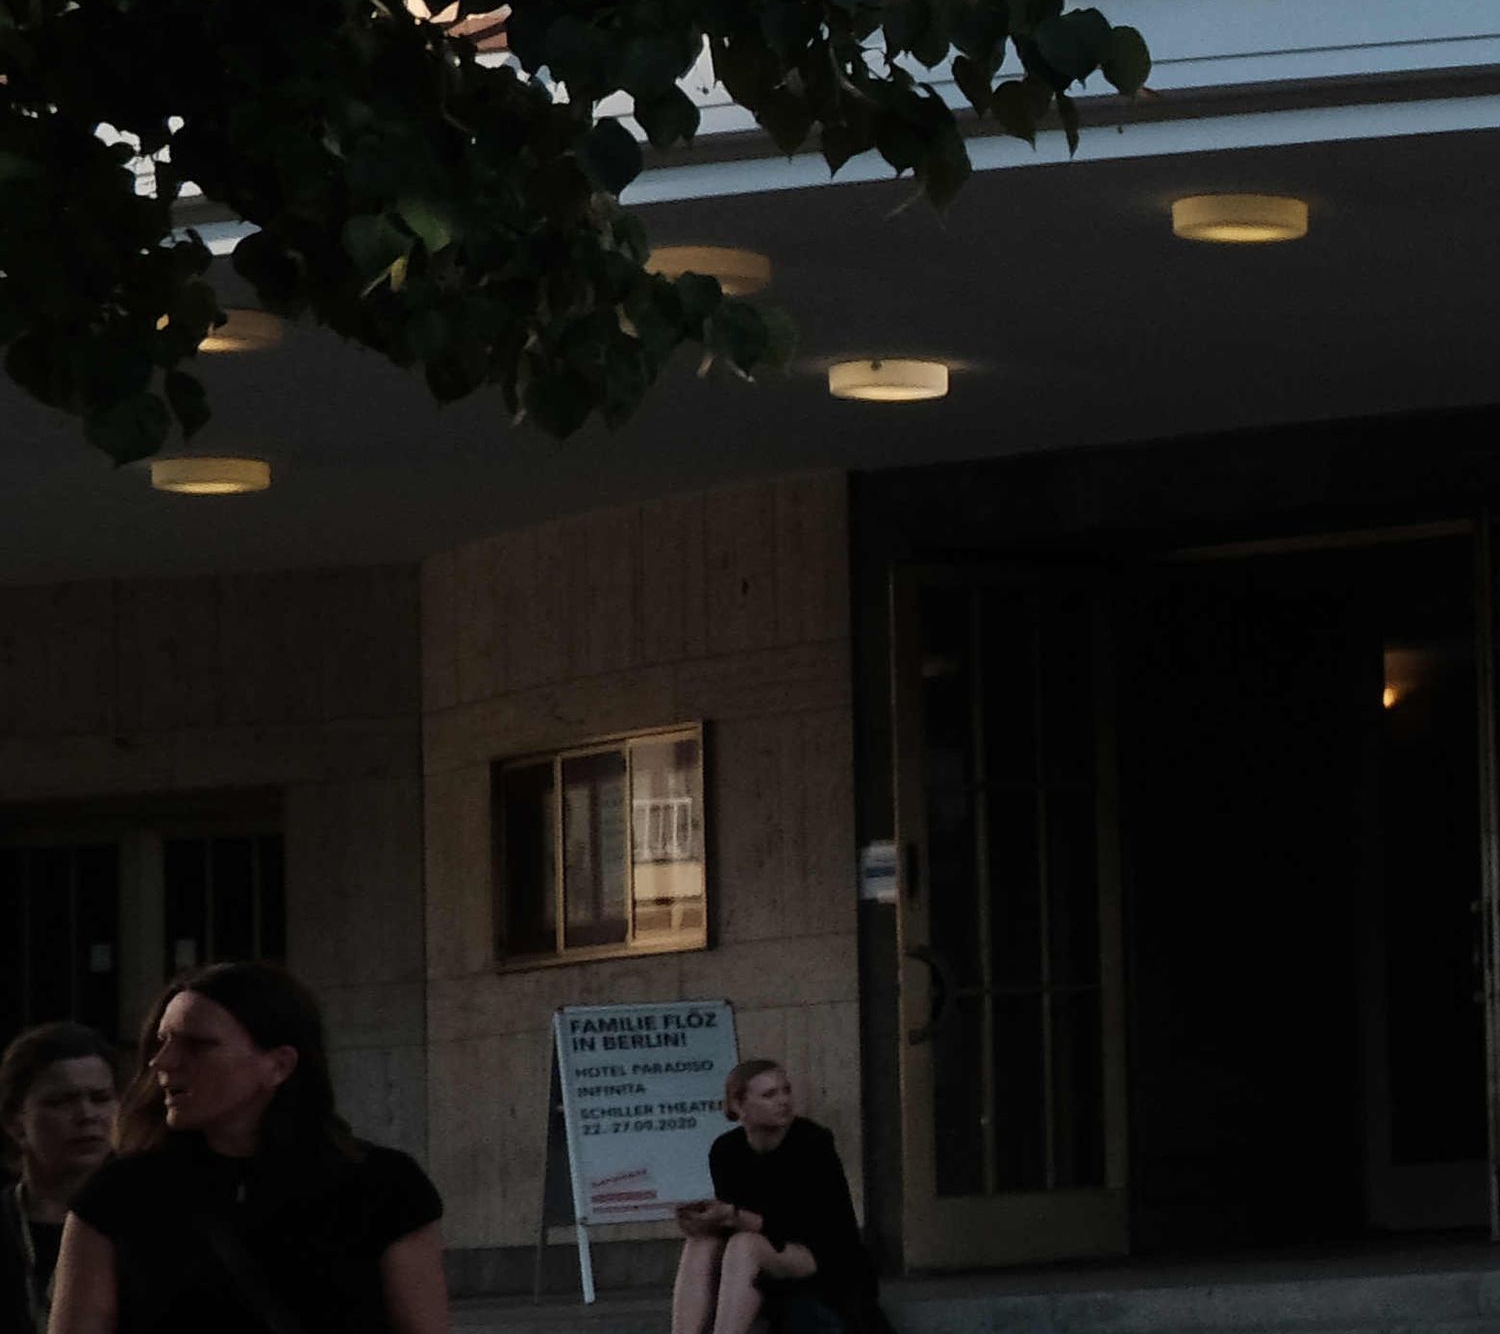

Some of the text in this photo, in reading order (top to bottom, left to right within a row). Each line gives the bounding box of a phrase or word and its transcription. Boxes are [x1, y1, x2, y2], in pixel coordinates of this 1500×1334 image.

[569, 1008, 718, 1034] FAMILIE FLÖZ
[572, 1032, 688, 1052] IN BERLIN!
[575, 1059, 715, 1078] HOTEL PARADISO
[580, 1100, 723, 1119] SCHILLER THEATE
